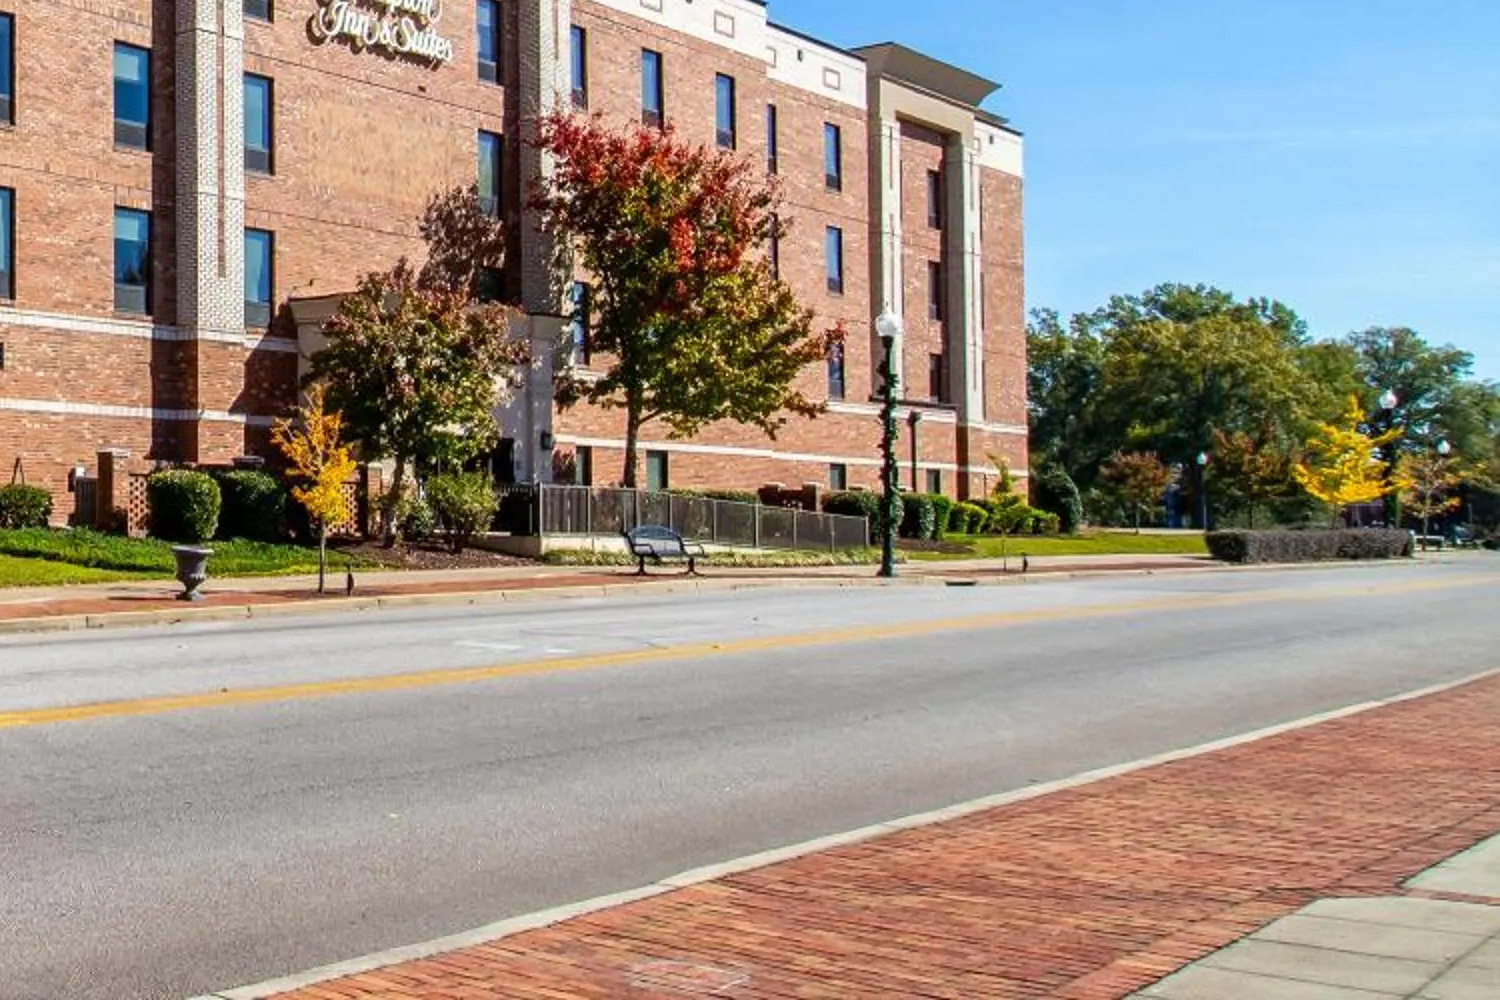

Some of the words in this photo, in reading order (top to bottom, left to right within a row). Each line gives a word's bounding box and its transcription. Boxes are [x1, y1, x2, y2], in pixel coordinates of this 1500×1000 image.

[319, 1, 380, 44] Inn
[380, 20, 392, 45] &
[392, 17, 453, 61] Suites
